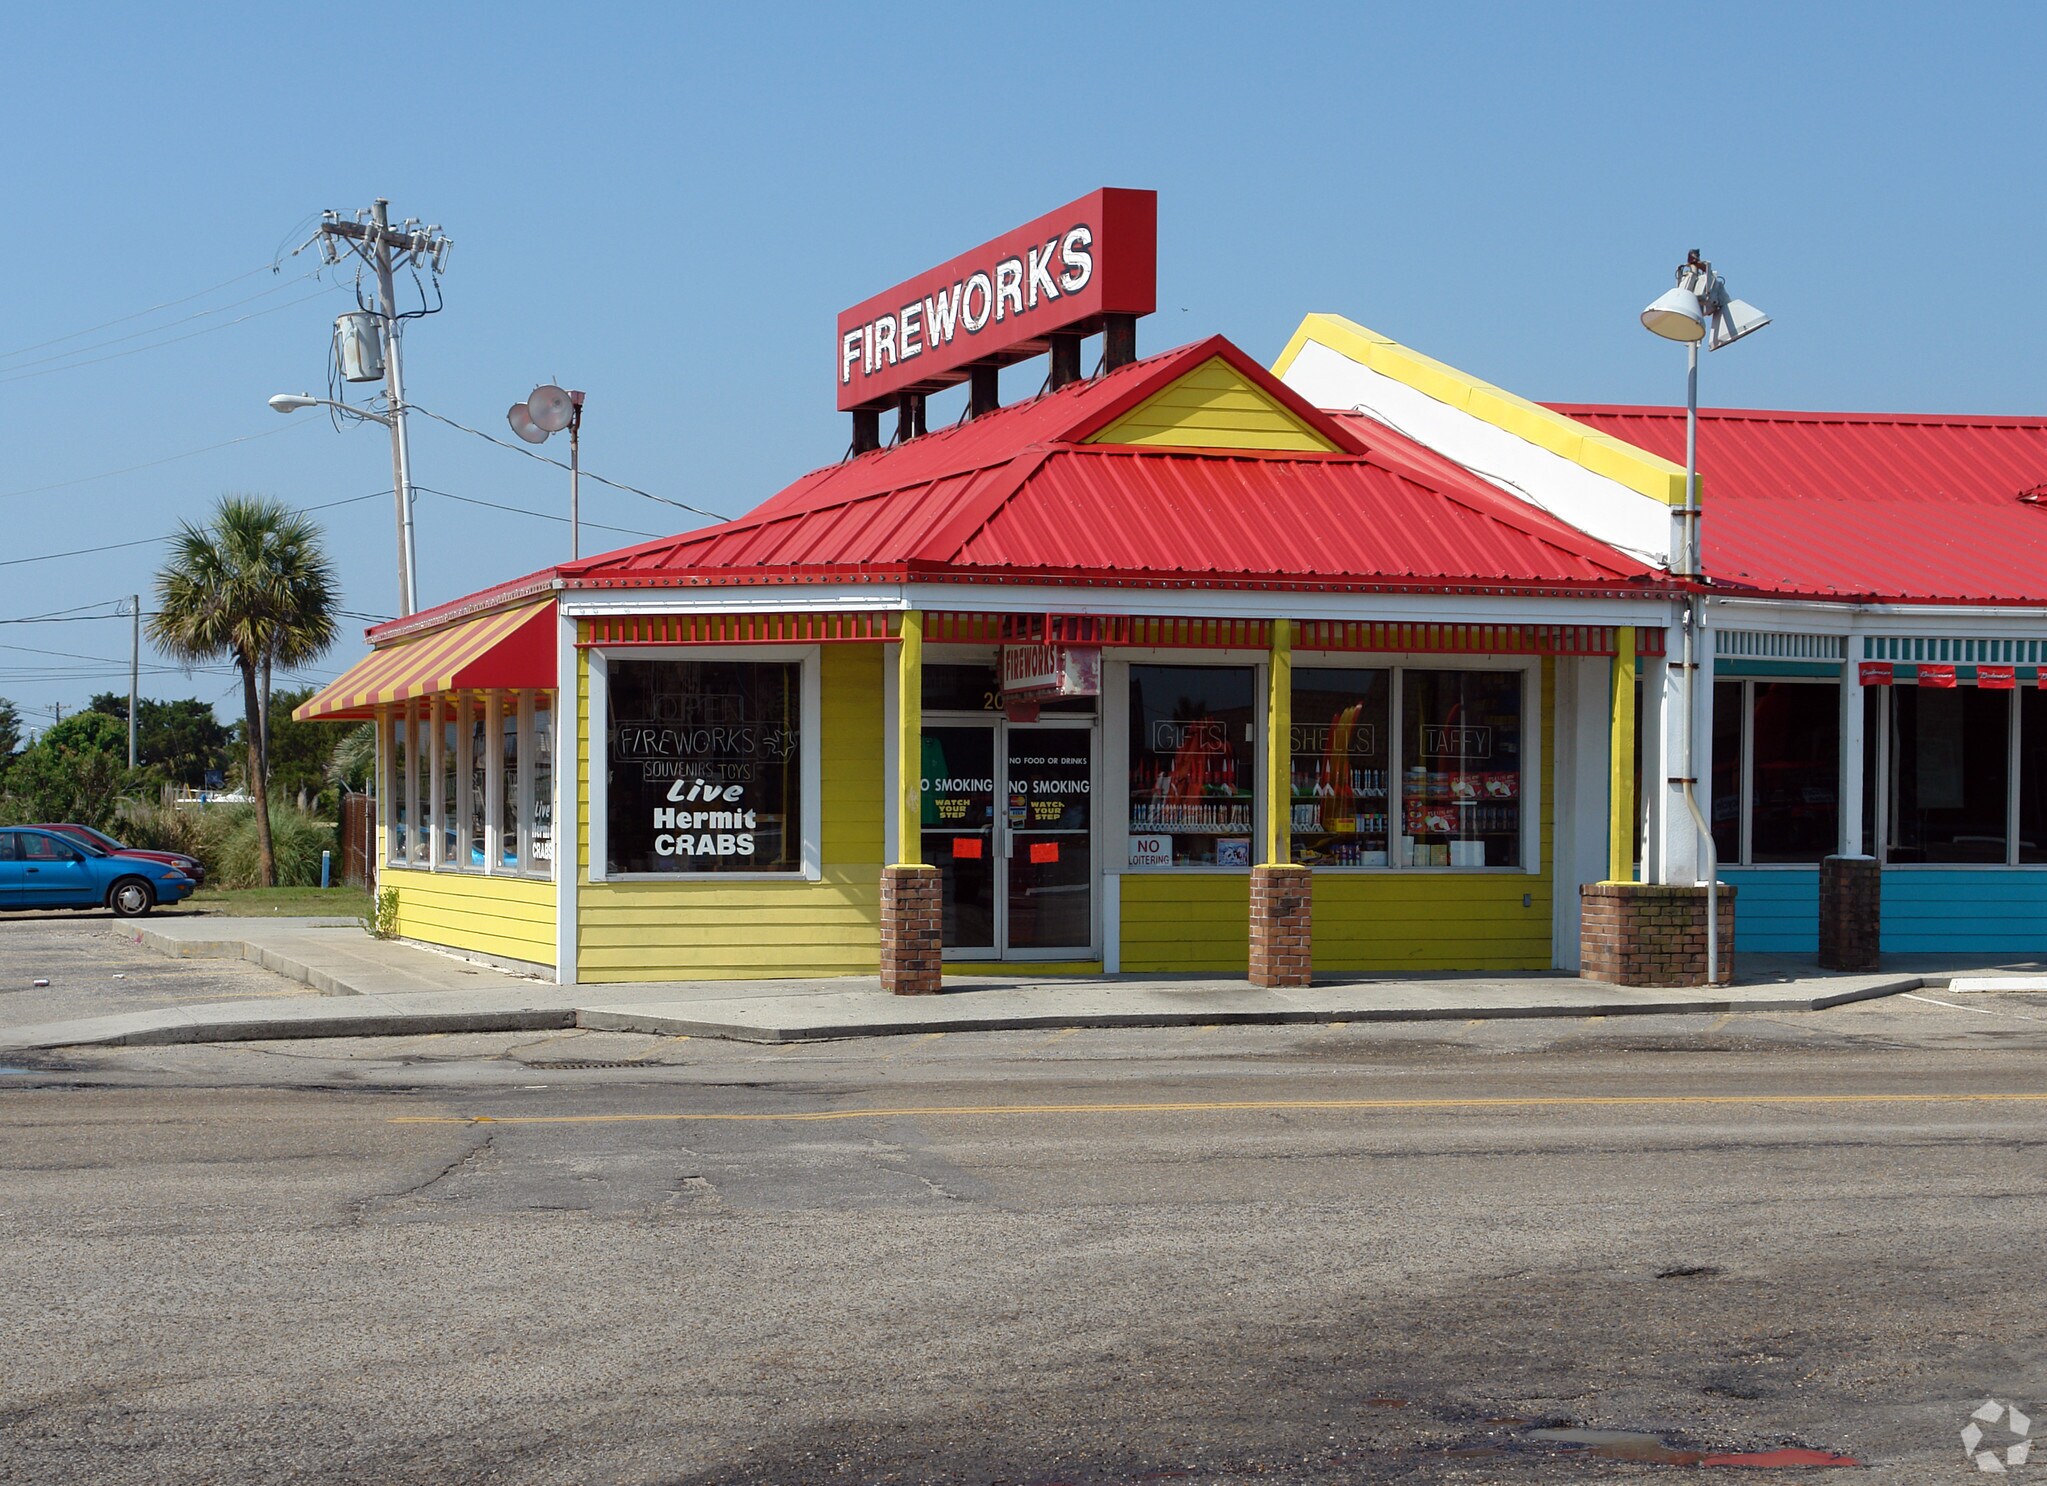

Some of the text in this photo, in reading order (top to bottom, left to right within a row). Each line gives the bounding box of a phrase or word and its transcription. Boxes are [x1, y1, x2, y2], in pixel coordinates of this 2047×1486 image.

[840, 223, 1093, 385] FIREWORKS
[1006, 645, 1055, 681] FIREWORKS
[656, 696, 743, 722] OPEN
[621, 728, 755, 756] FIREWORKS
[1157, 724, 1223, 750] GIFTS
[1290, 727, 1370, 752] SHELLS
[1425, 729, 1487, 754] TAFFY
[645, 761, 752, 781] SOUVENIRS TOYS
[1009, 757, 1088, 765] NO FOOD OR DRINKS
[666, 778, 744, 803] Live
[921, 778, 993, 792] O SMOKING
[1008, 780, 1090, 794] NO SMOKING
[534, 801, 550, 818] Live
[653, 808, 757, 829] Hermit
[531, 823, 552, 839] Hermi
[532, 842, 552, 859] CRABS
[654, 834, 756, 857] CRABS
[1137, 839, 1160, 853] NO
[1128, 855, 1170, 865] LOITERING
